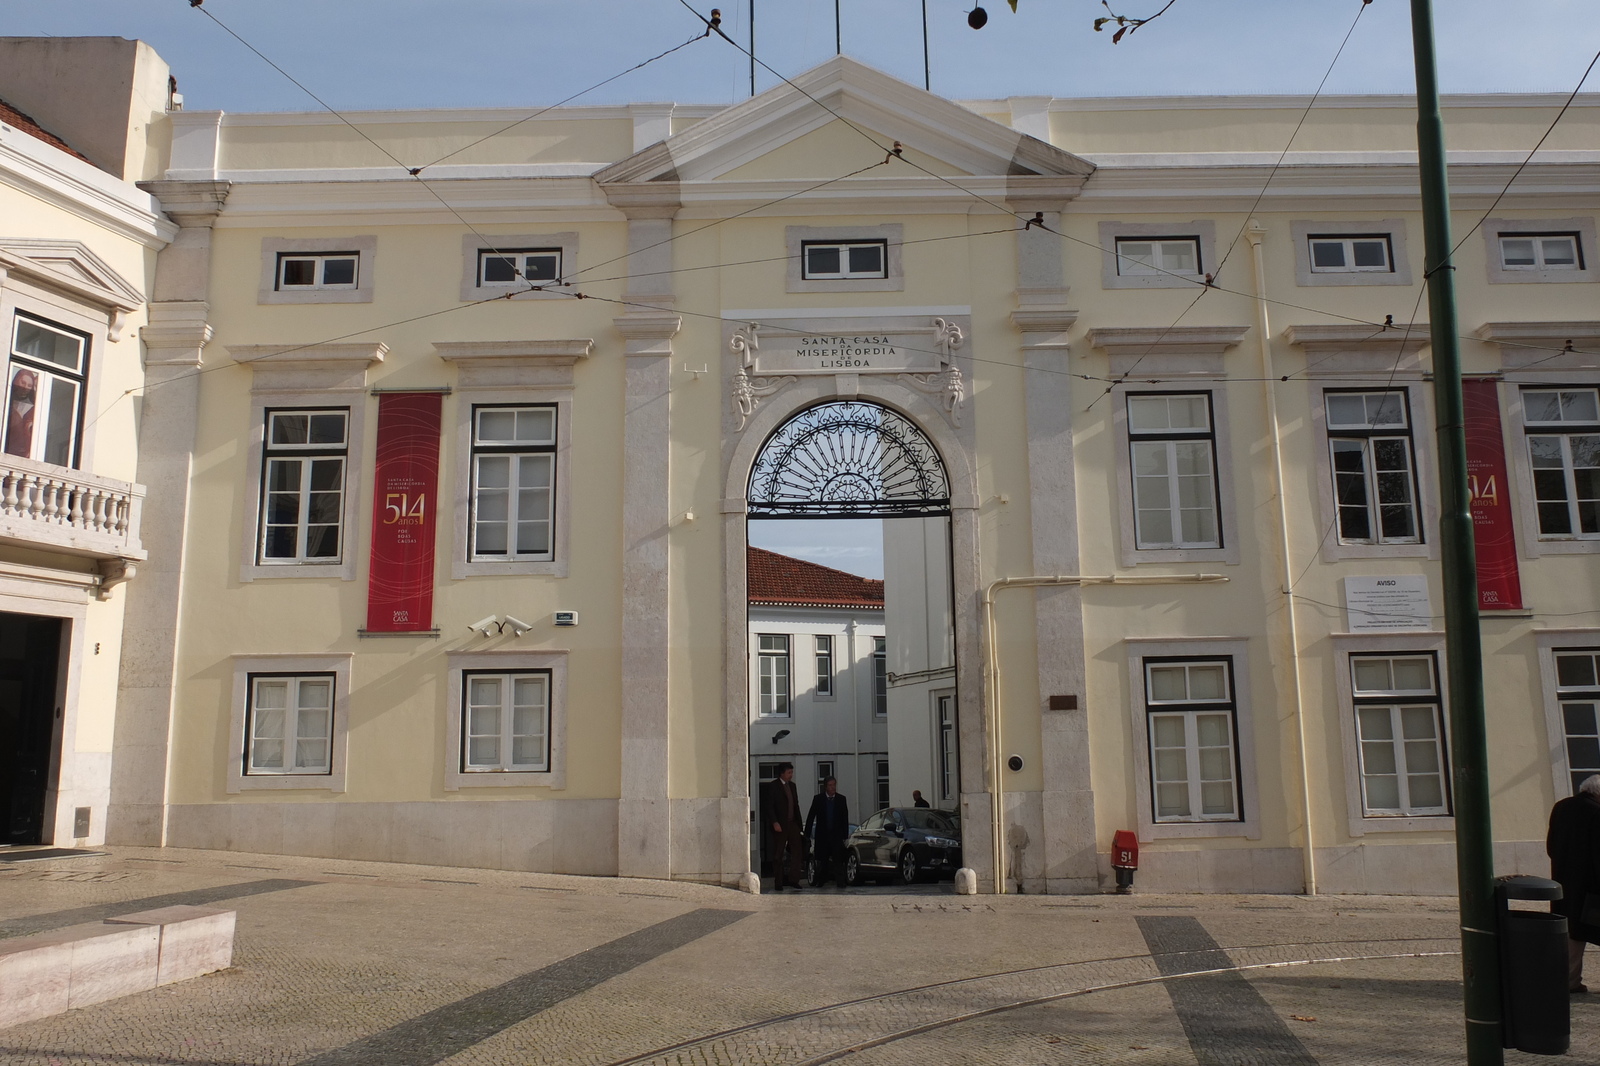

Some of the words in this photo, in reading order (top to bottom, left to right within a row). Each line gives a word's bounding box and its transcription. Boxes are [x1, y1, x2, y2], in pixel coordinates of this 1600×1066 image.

[802, 337, 846, 345] SANTA
[854, 336, 889, 344] CASA
[796, 348, 896, 357] MISERICORDIA
[383, 493, 425, 525] 514
